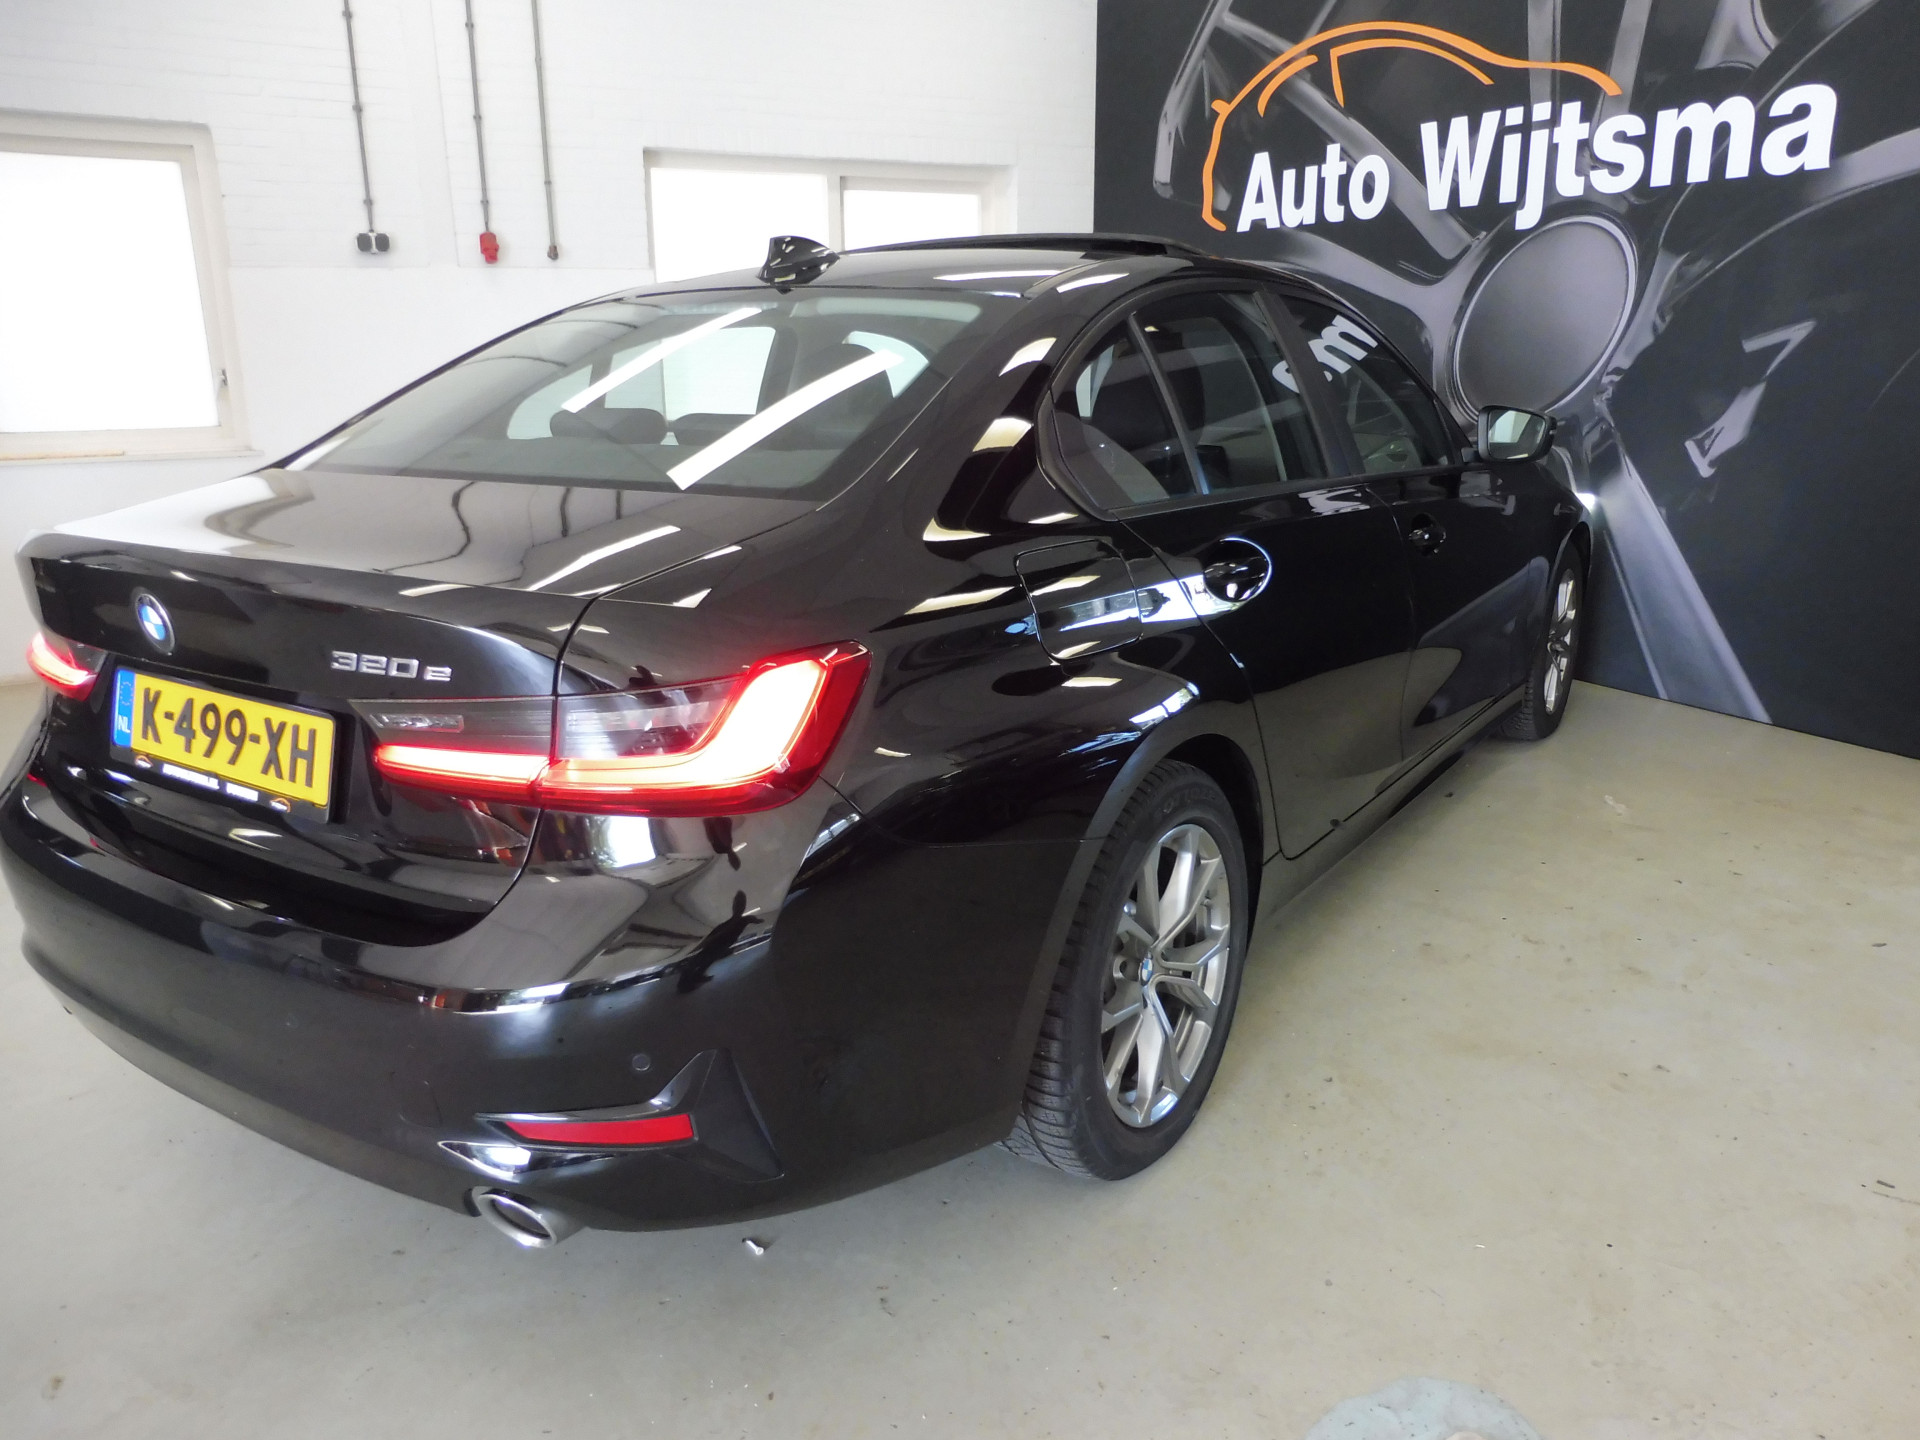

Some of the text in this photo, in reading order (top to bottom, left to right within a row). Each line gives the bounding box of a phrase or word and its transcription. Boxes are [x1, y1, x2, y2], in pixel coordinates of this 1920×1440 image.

[1237, 84, 1838, 233] Auto Wijtsma
[117, 714, 131, 733] NL
[141, 687, 317, 788] K-499-XH
